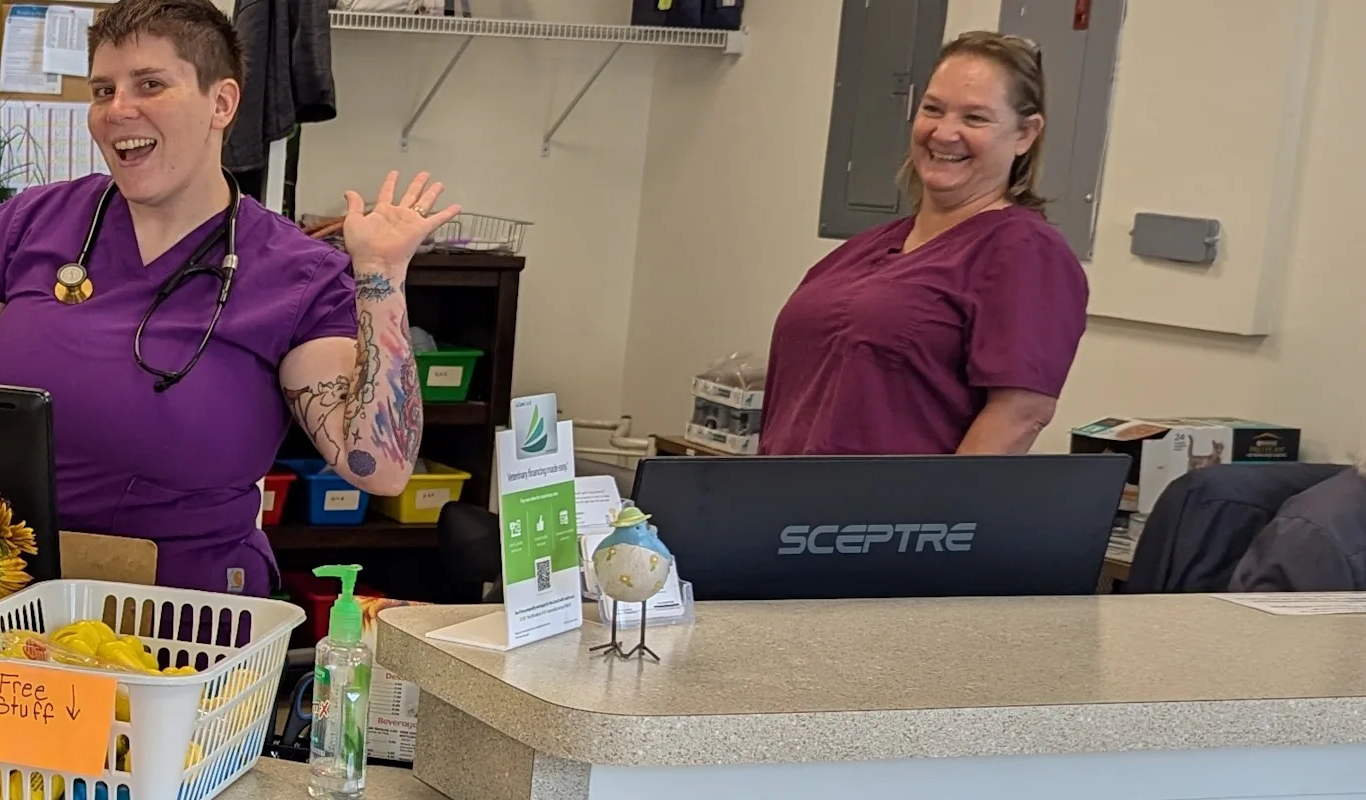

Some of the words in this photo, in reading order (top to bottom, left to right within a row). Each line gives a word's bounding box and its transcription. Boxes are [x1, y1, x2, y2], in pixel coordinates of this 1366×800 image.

[1174, 433, 1185, 442] 24
[778, 522, 977, 554] SCEPTRE
[0, 673, 48, 701] Free
